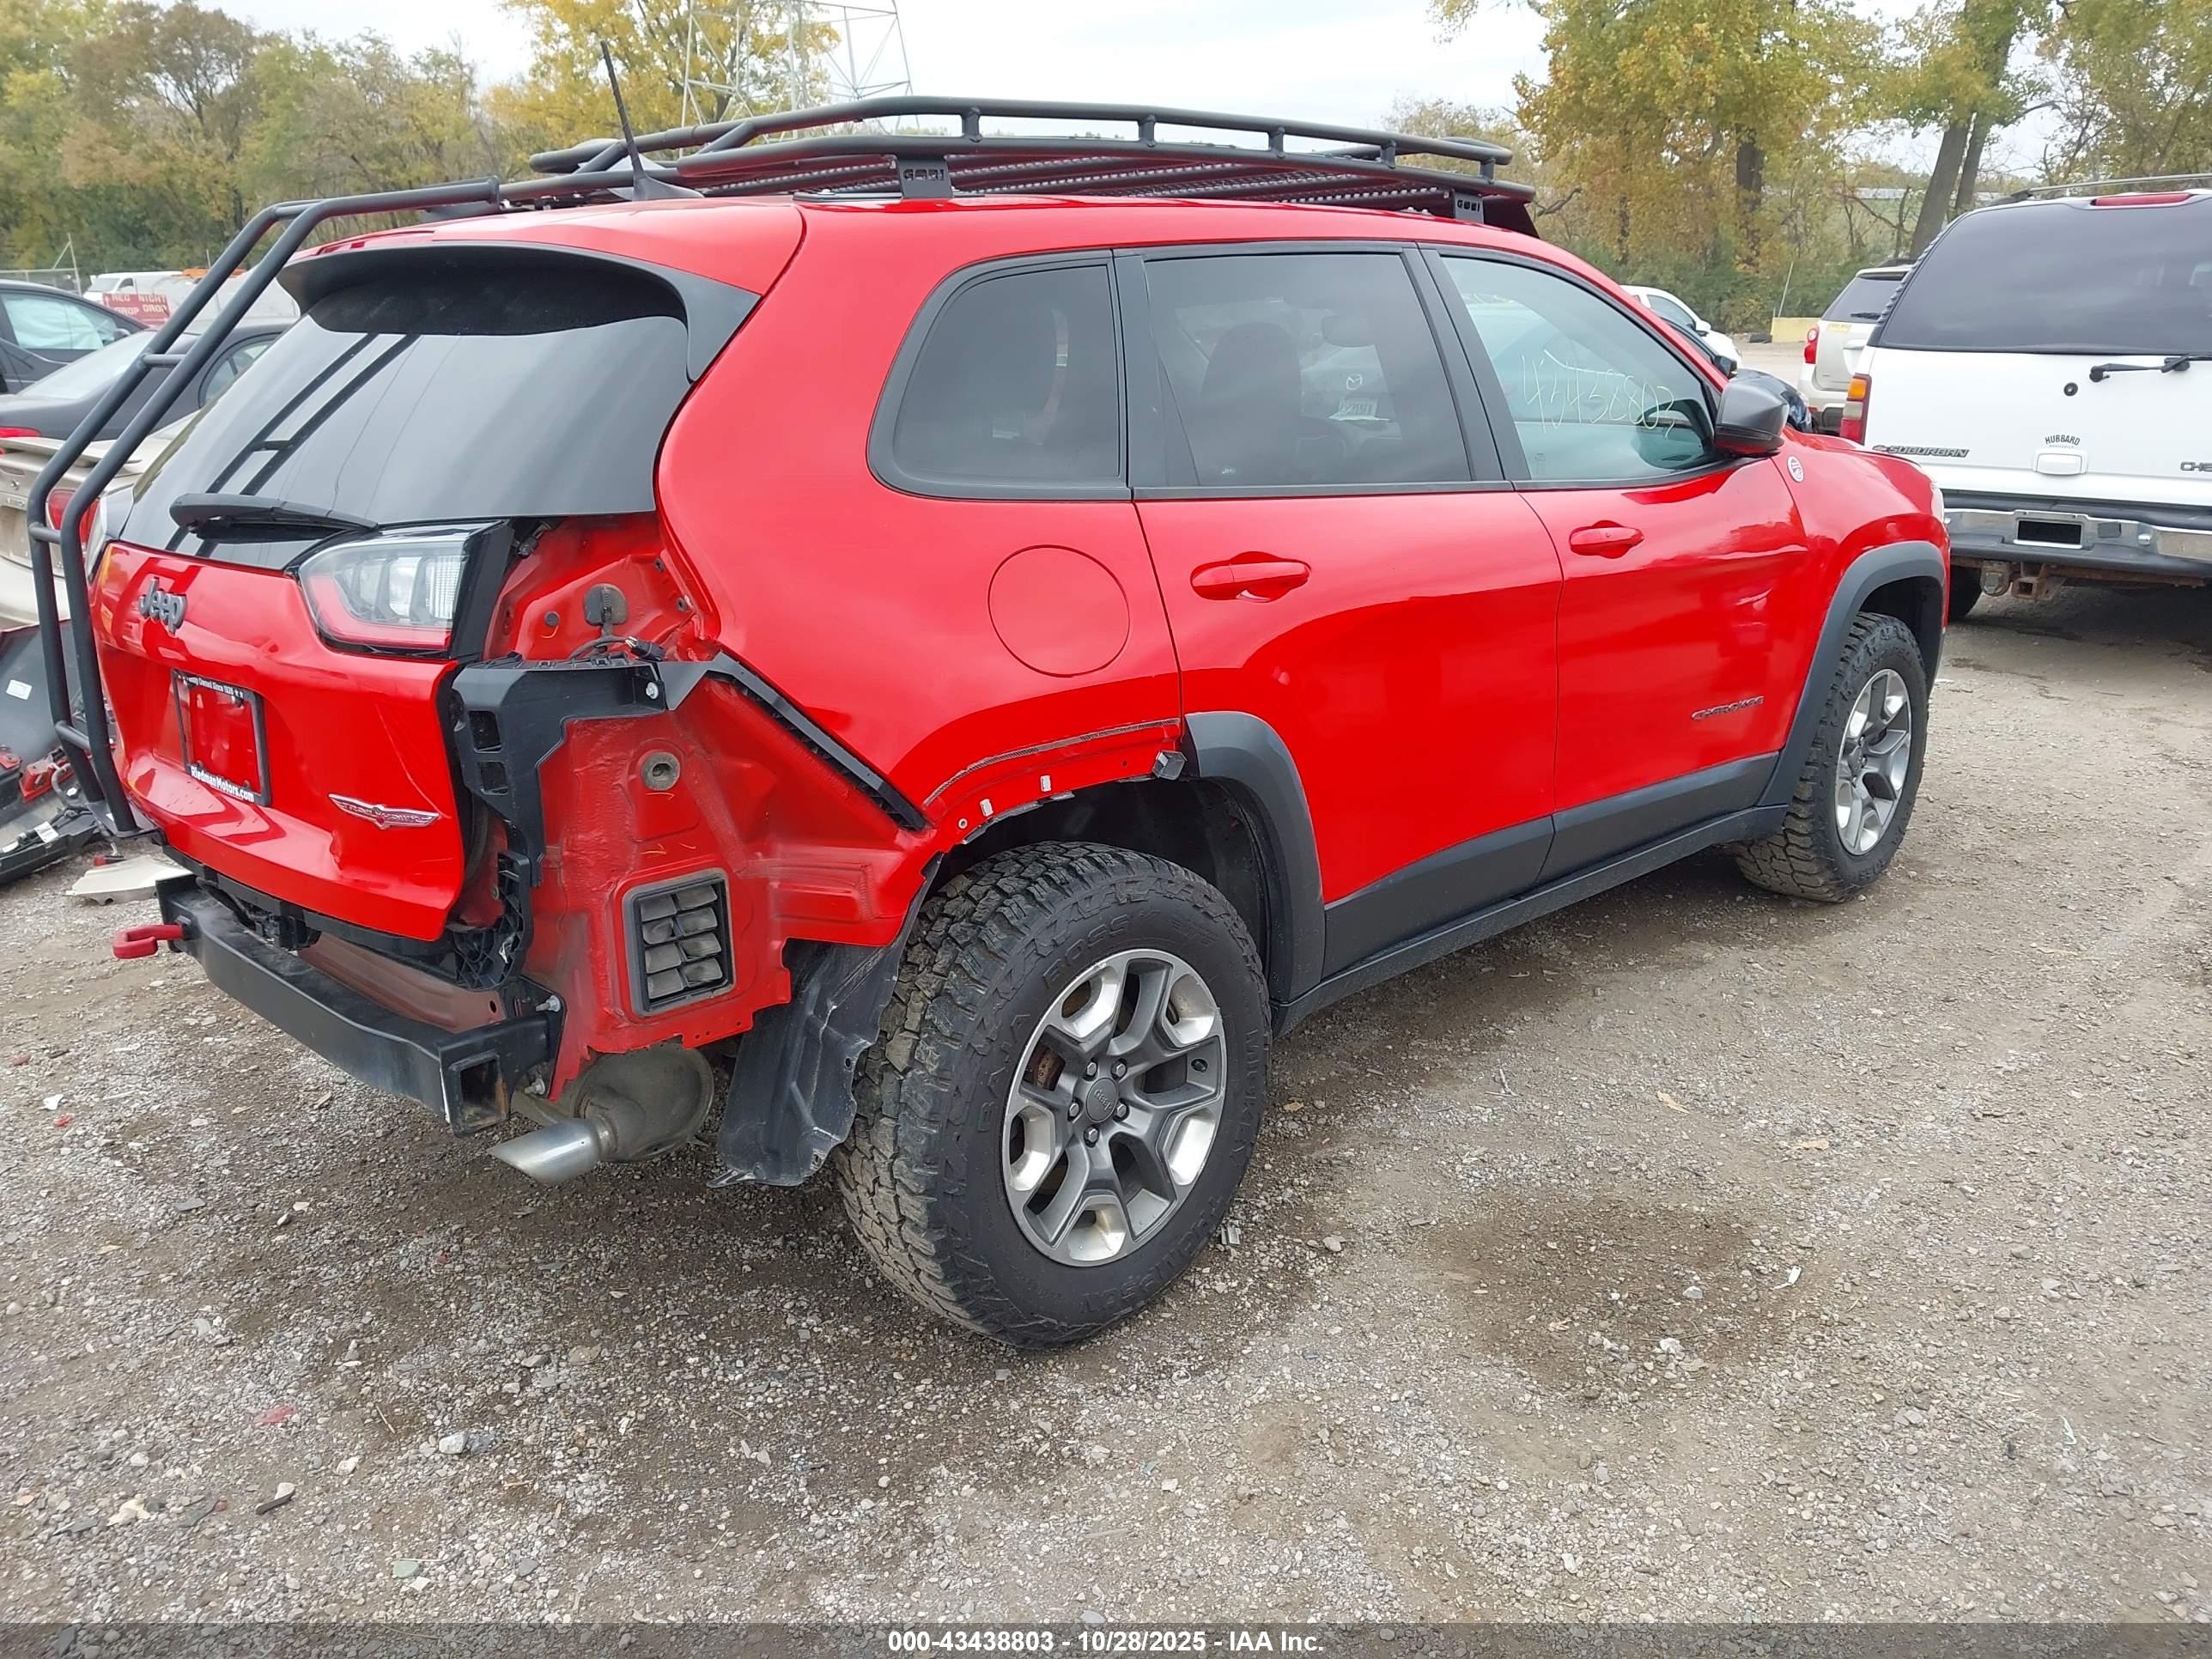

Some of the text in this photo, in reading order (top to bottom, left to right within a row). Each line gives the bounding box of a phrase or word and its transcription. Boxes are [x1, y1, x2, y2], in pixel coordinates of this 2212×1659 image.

[137, 294, 167, 303] NIGHT
[143, 304, 167, 313] DROP
[2045, 434, 2081, 447] HUBBARD
[1887, 445, 1970, 458] SUBURBAN
[138, 577, 186, 635] Jeep
[191, 766, 255, 803] RiedmanMotors.com
